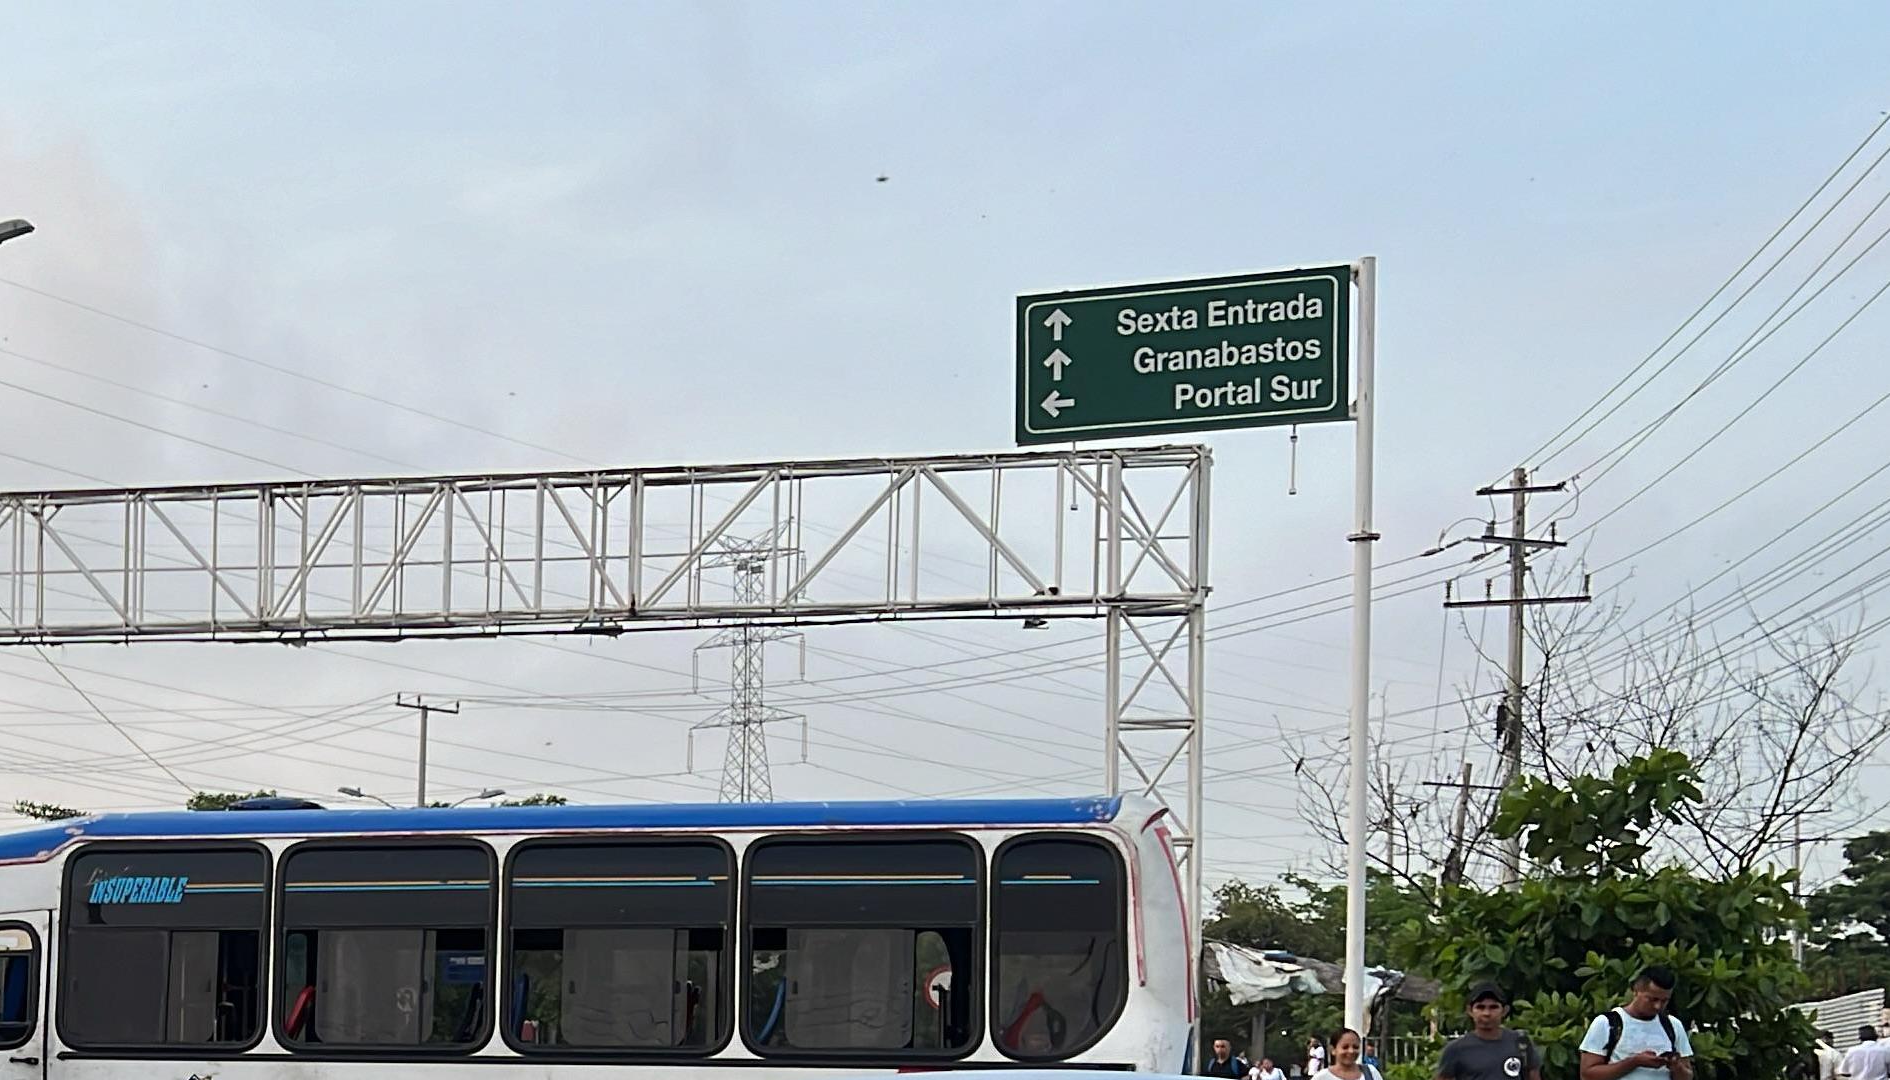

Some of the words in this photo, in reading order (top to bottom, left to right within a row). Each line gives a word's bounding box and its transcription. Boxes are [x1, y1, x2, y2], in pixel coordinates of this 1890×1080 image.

[1116, 306, 1199, 336] Sexta
[1207, 293, 1323, 327] Entrada
[1133, 337, 1322, 374] Granabastos
[1175, 378, 1261, 410] Portal
[1270, 376, 1322, 402] Sur
[89, 876, 188, 904] INSUPERABLE
